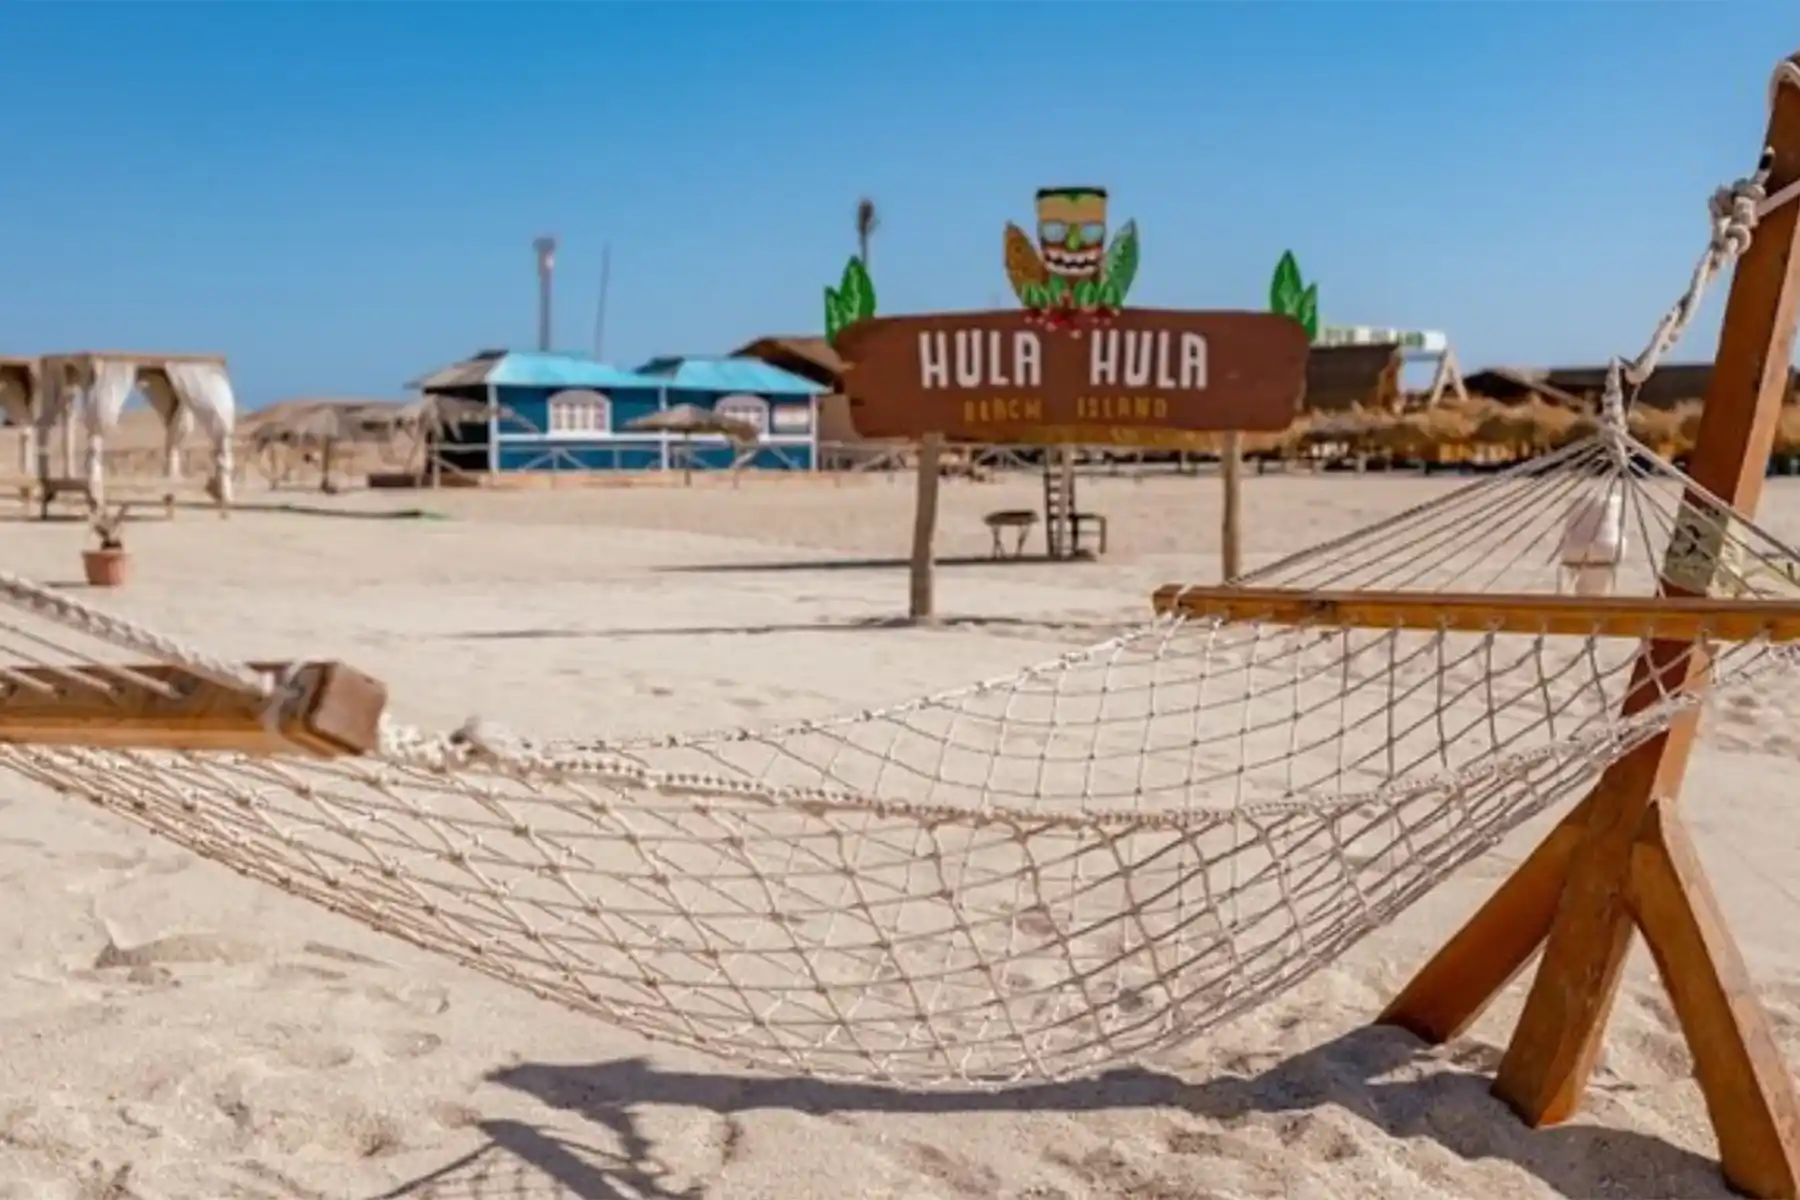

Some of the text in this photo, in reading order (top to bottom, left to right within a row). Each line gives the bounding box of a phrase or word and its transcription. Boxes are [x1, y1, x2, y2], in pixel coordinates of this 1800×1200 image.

[919, 328, 1209, 390] HULA HULA
[1076, 396, 1169, 420] ISLAND
